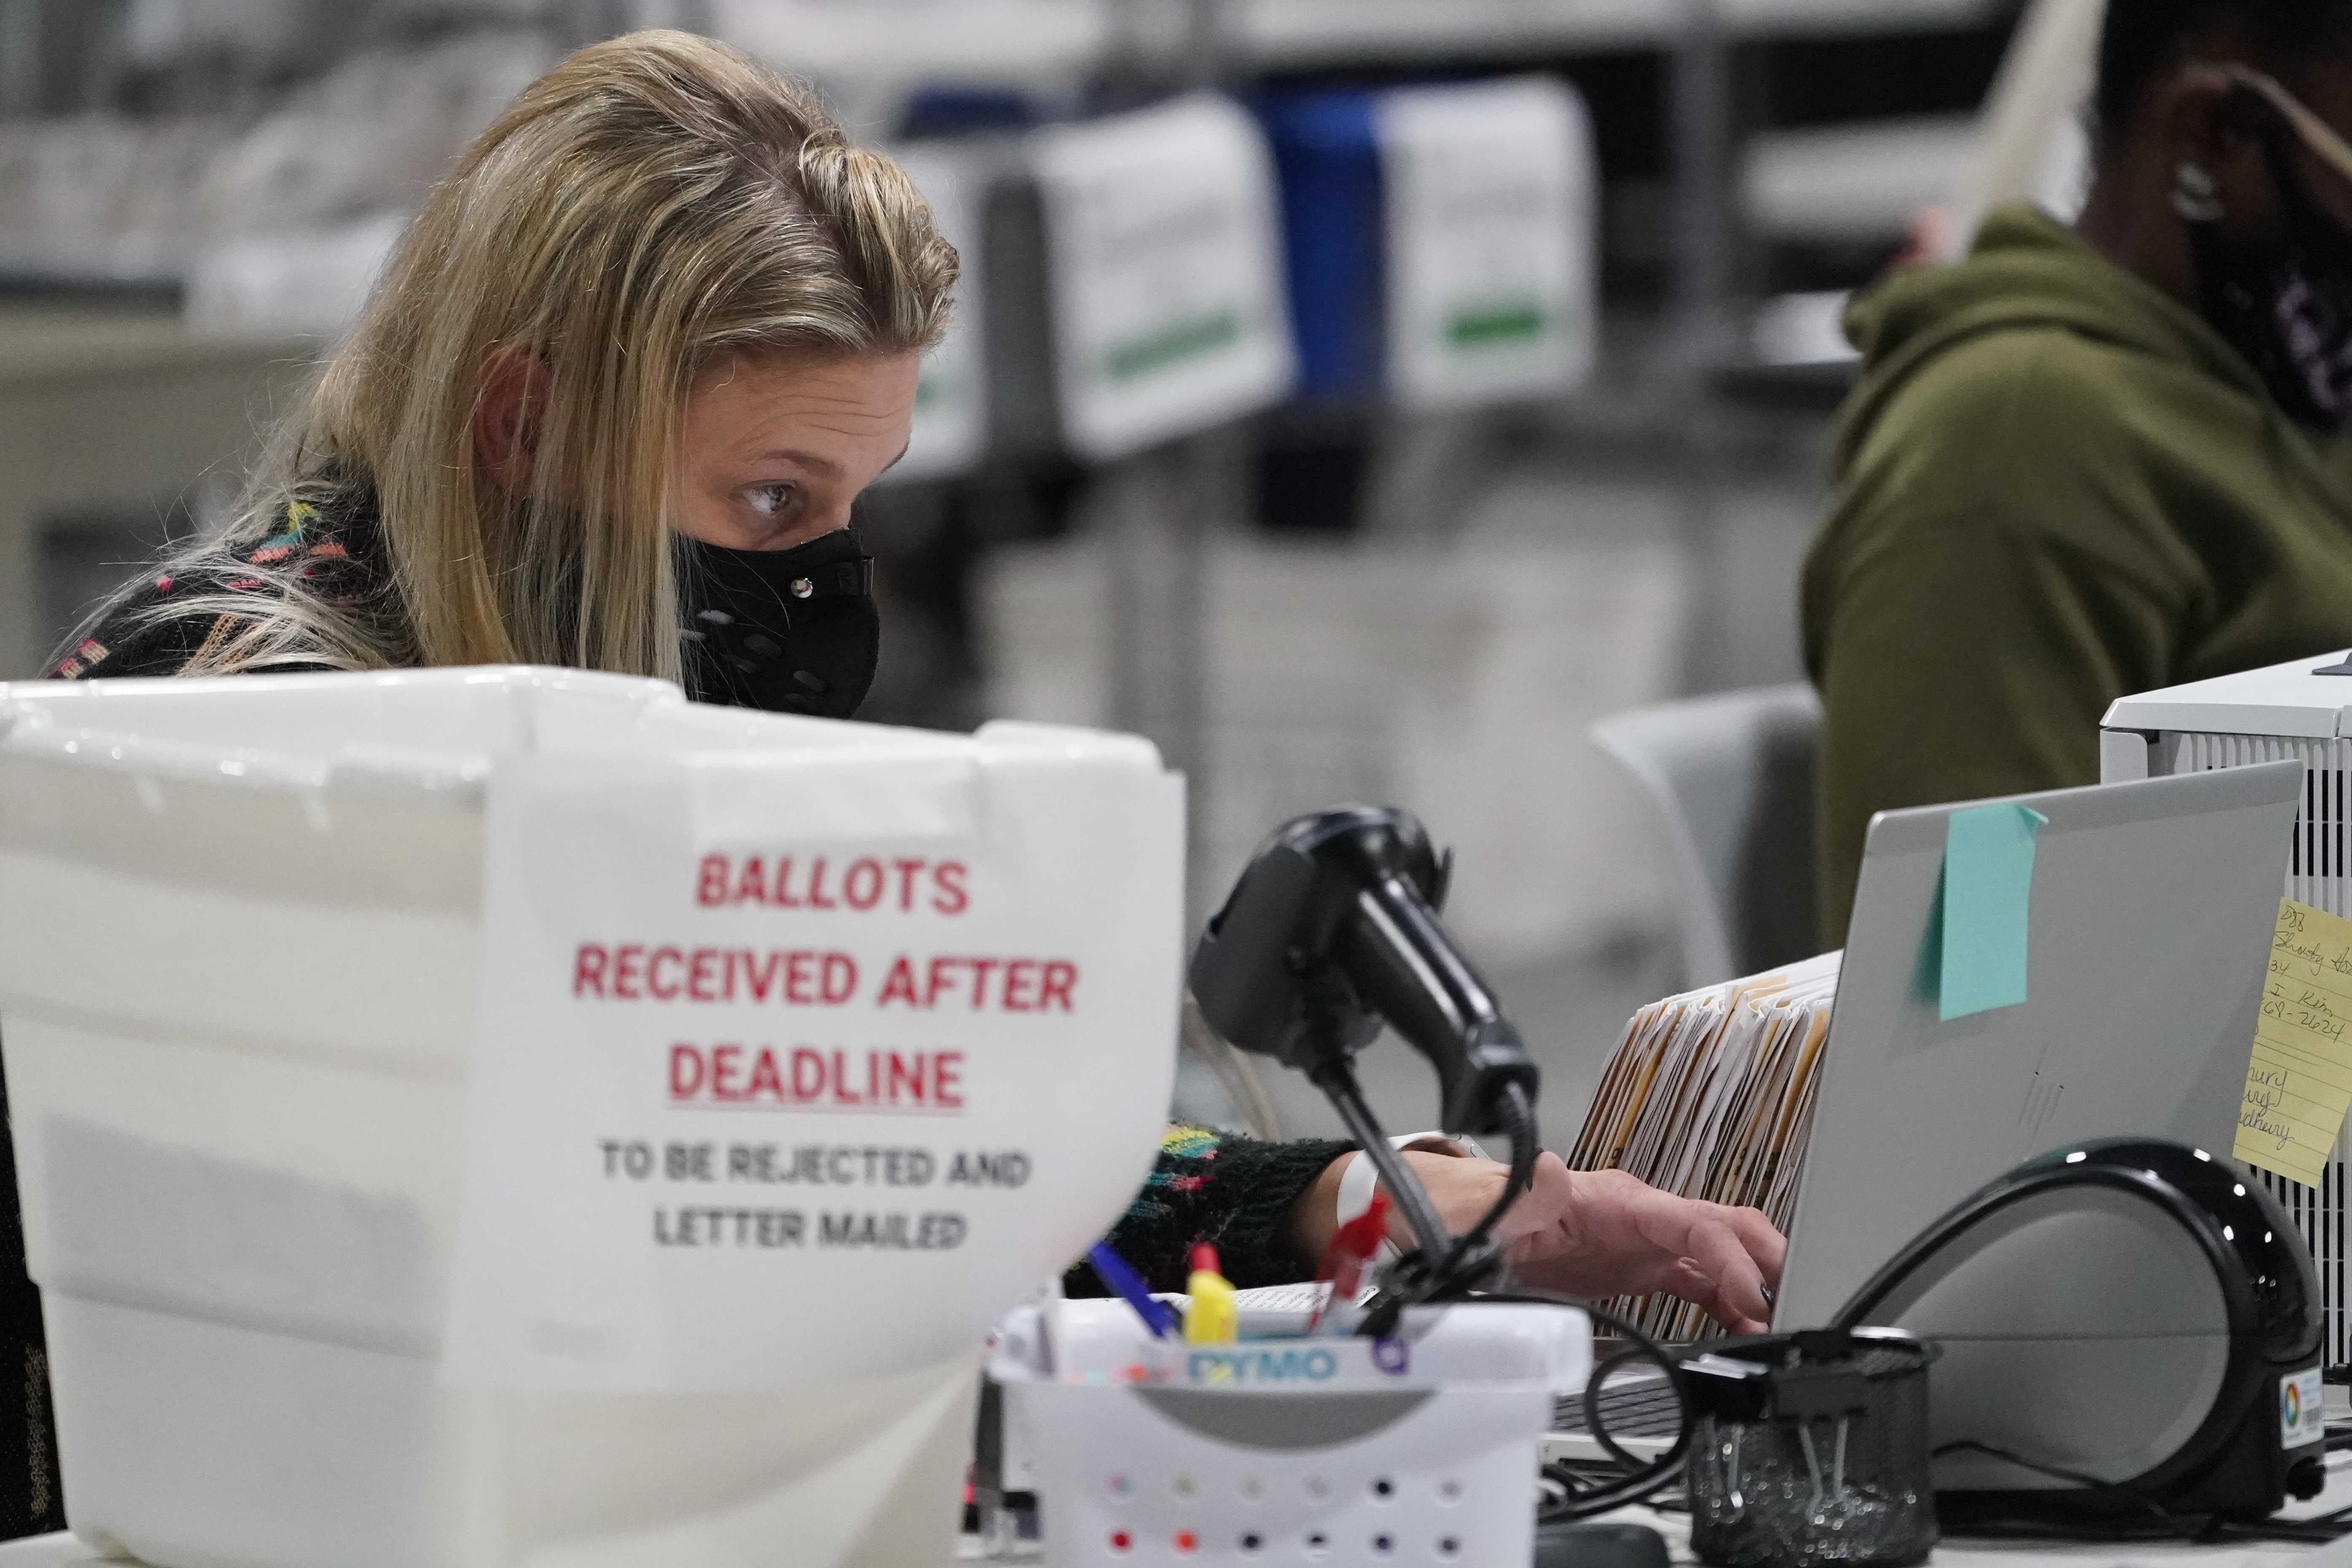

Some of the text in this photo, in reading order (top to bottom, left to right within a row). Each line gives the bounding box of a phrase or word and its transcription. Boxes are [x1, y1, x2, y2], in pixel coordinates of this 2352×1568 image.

[695, 853, 970, 915] BALLOTS
[573, 943, 1078, 1012] RECEIVED AFTER
[669, 1043, 965, 1109] DEADLINE
[601, 1139, 1032, 1190] TO BE REJECTED AND
[653, 1206, 968, 1252] LETTER MAILED
[1186, 1348, 1339, 1384] DYMO
